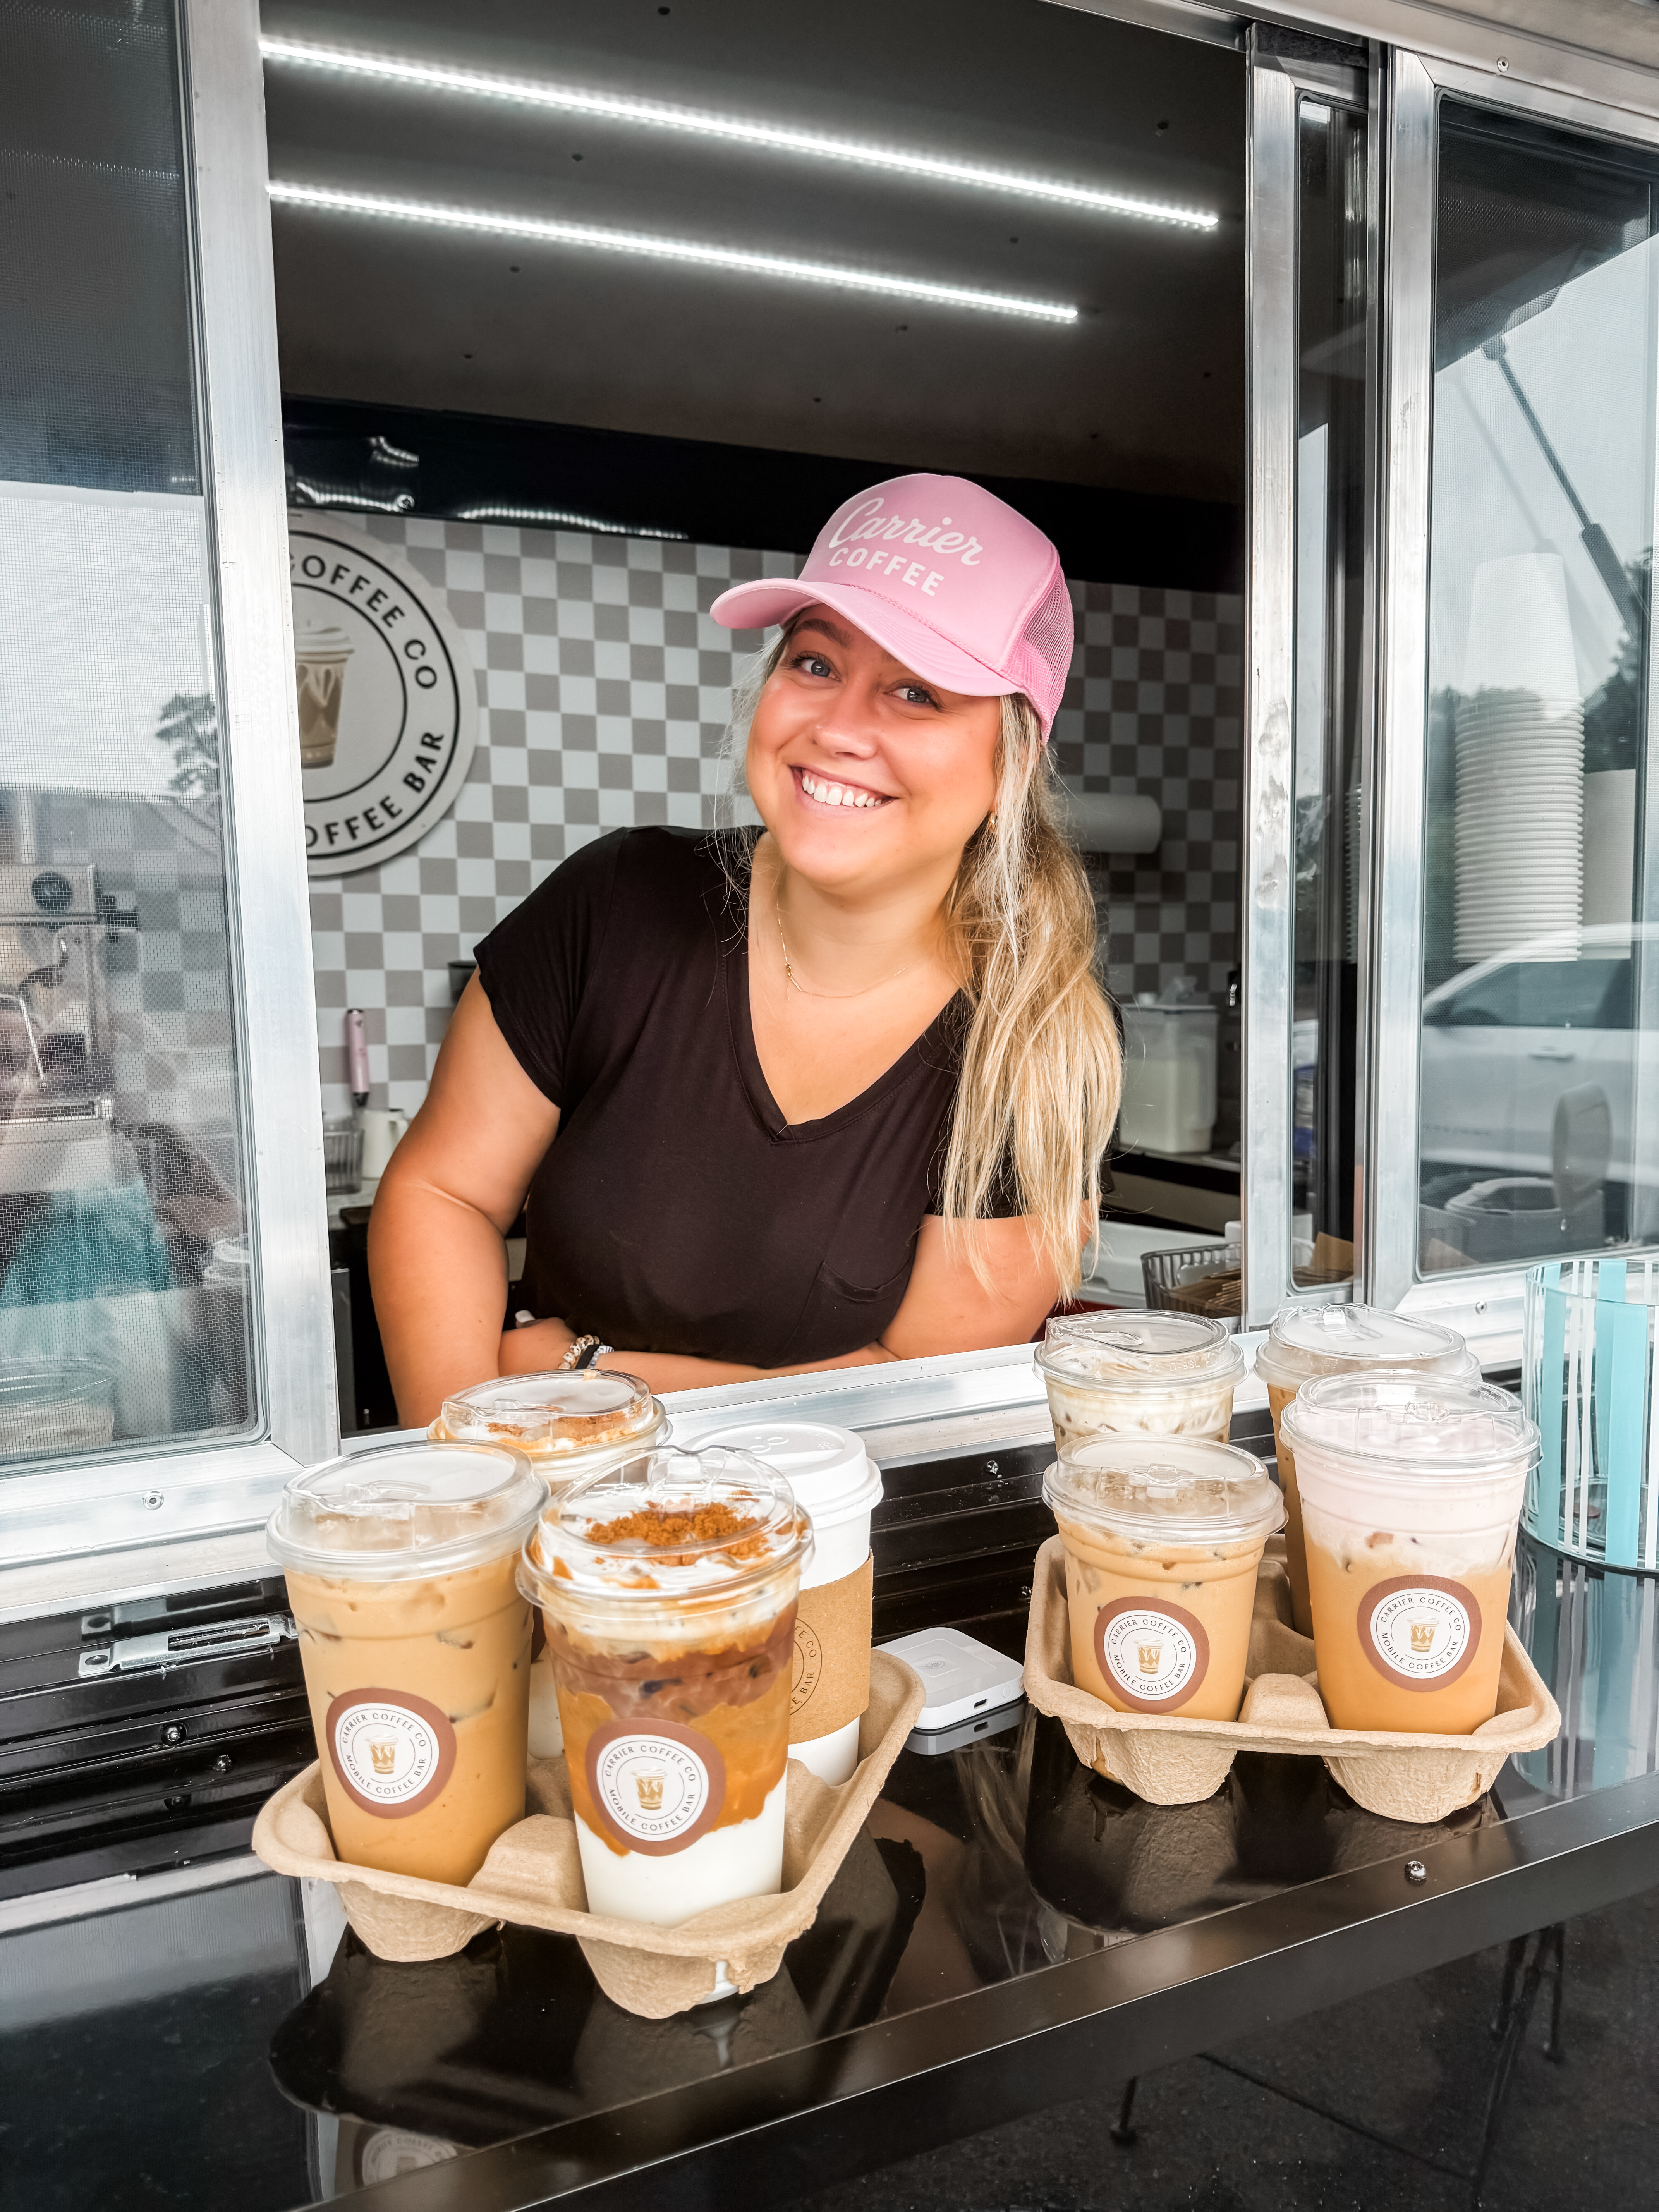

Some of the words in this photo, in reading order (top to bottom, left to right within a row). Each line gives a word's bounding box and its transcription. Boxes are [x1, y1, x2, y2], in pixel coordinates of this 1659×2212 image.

[829, 497, 983, 566] Carrier
[829, 547, 945, 597] COFFEE
[290, 554, 405, 628] OFFEE
[404, 638, 438, 690] CO
[305, 795, 403, 848] OFFEE
[403, 731, 444, 793] BAR
[1381, 1598, 1414, 1623] CARRIER
[1420, 1597, 1455, 1615] COFFEE
[1453, 1618, 1461, 1631] CO
[806, 1640, 817, 1657] CO
[1111, 1620, 1138, 1644] CARRIER
[1143, 1619, 1178, 1638] COFFEE
[1178, 1640, 1187, 1653] CO
[1382, 1633, 1405, 1664] MOBILE
[1409, 1658, 1446, 1670] COFFEE
[1446, 1641, 1458, 1657] BAR
[800, 1673, 815, 1694] BAR
[1114, 1654, 1136, 1686] MOBILE
[1140, 1679, 1175, 1692] COFFEE
[1174, 1663, 1185, 1679] BAR
[342, 1714, 368, 1743] CARRIER
[373, 1713, 414, 1731] COFFEE
[415, 1733, 426, 1747] CO
[346, 1755, 372, 1789] MOBILE
[376, 1778, 415, 1794] COFFEE
[414, 1759, 426, 1777] BAR
[605, 1746, 635, 1777] CARRIER
[640, 1745, 685, 1765] COFFEE
[684, 1766, 696, 1781] CO
[609, 1789, 637, 1825] MOBILE
[641, 1814, 683, 1831] COFFEE
[682, 1793, 696, 1812] BAR
